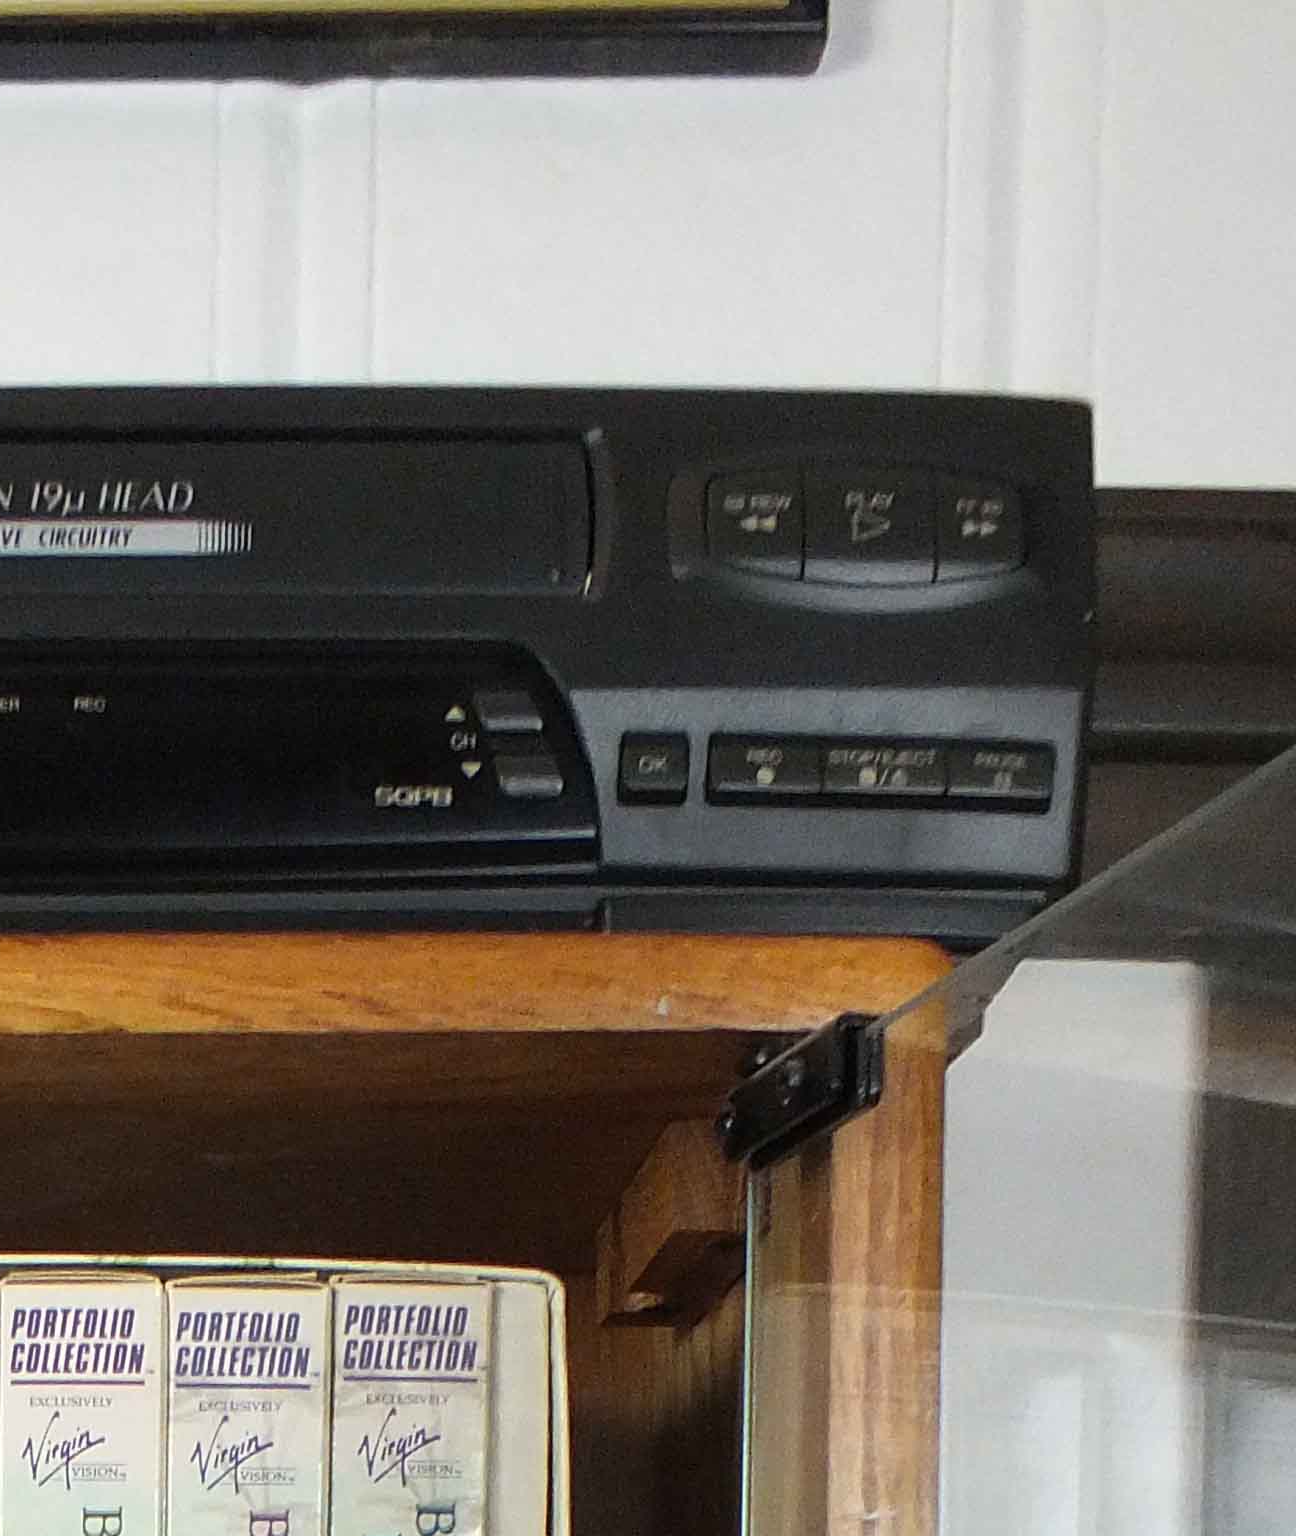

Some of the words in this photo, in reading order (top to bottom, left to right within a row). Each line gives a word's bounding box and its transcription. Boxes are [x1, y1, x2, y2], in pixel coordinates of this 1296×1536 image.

[97, 481, 194, 512] HEAD
[38, 527, 133, 548] CIRCUITRY
[73, 696, 106, 712] REC
[450, 732, 477, 752] CH
[10, 1308, 136, 1339] PORTFOLIO
[176, 1312, 301, 1343] PORTFOLIO
[9, 1342, 145, 1375] COLLECTION
[174, 1346, 310, 1379] COLLECTION
